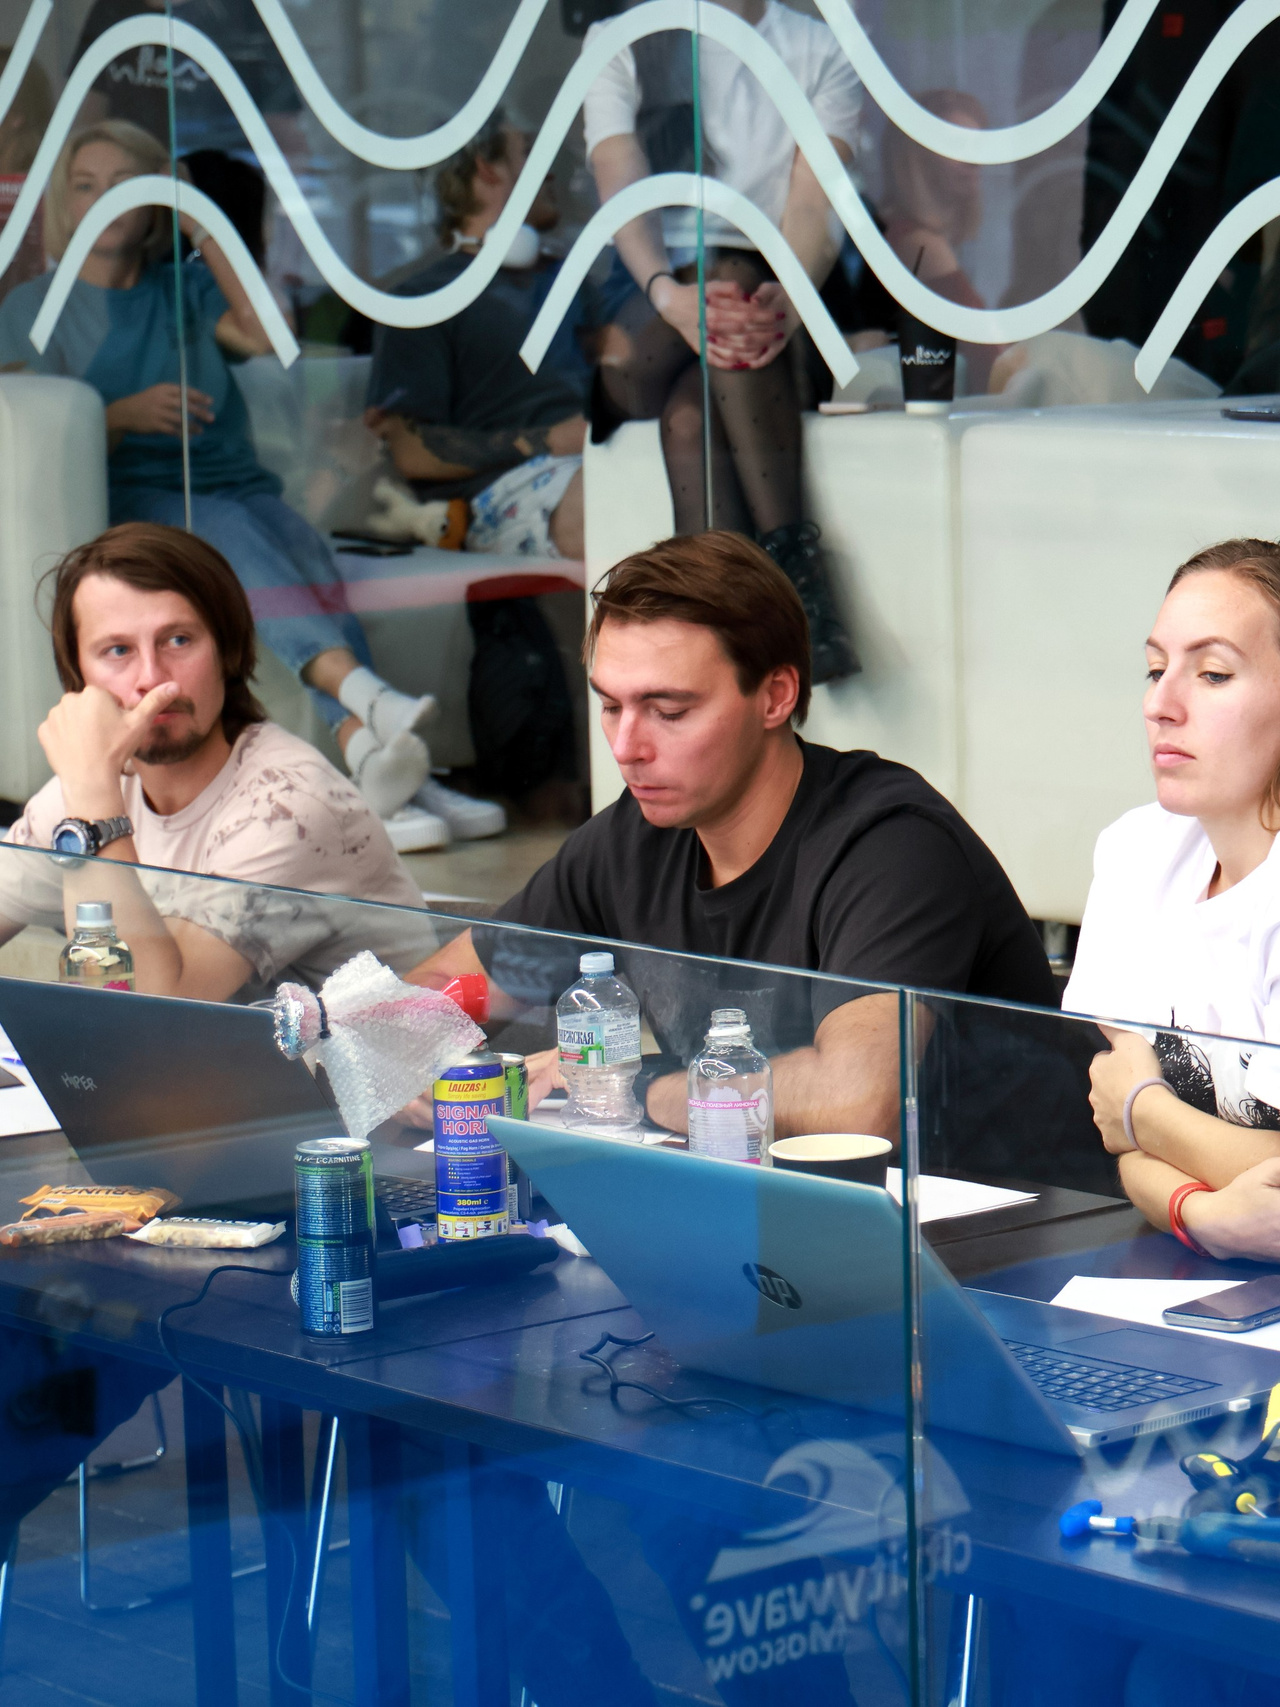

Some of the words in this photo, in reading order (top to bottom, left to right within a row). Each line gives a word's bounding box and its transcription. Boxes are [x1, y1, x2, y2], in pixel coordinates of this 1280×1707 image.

[559, 1028, 594, 1046] НЕЖСКАЯ
[61, 1072, 98, 1092] HIPER
[448, 1082, 481, 1093] LALIZAS
[437, 1103, 500, 1121] SIGNAL
[316, 1154, 361, 1164] L-CARNITINE
[749, 1262, 791, 1311] hp
